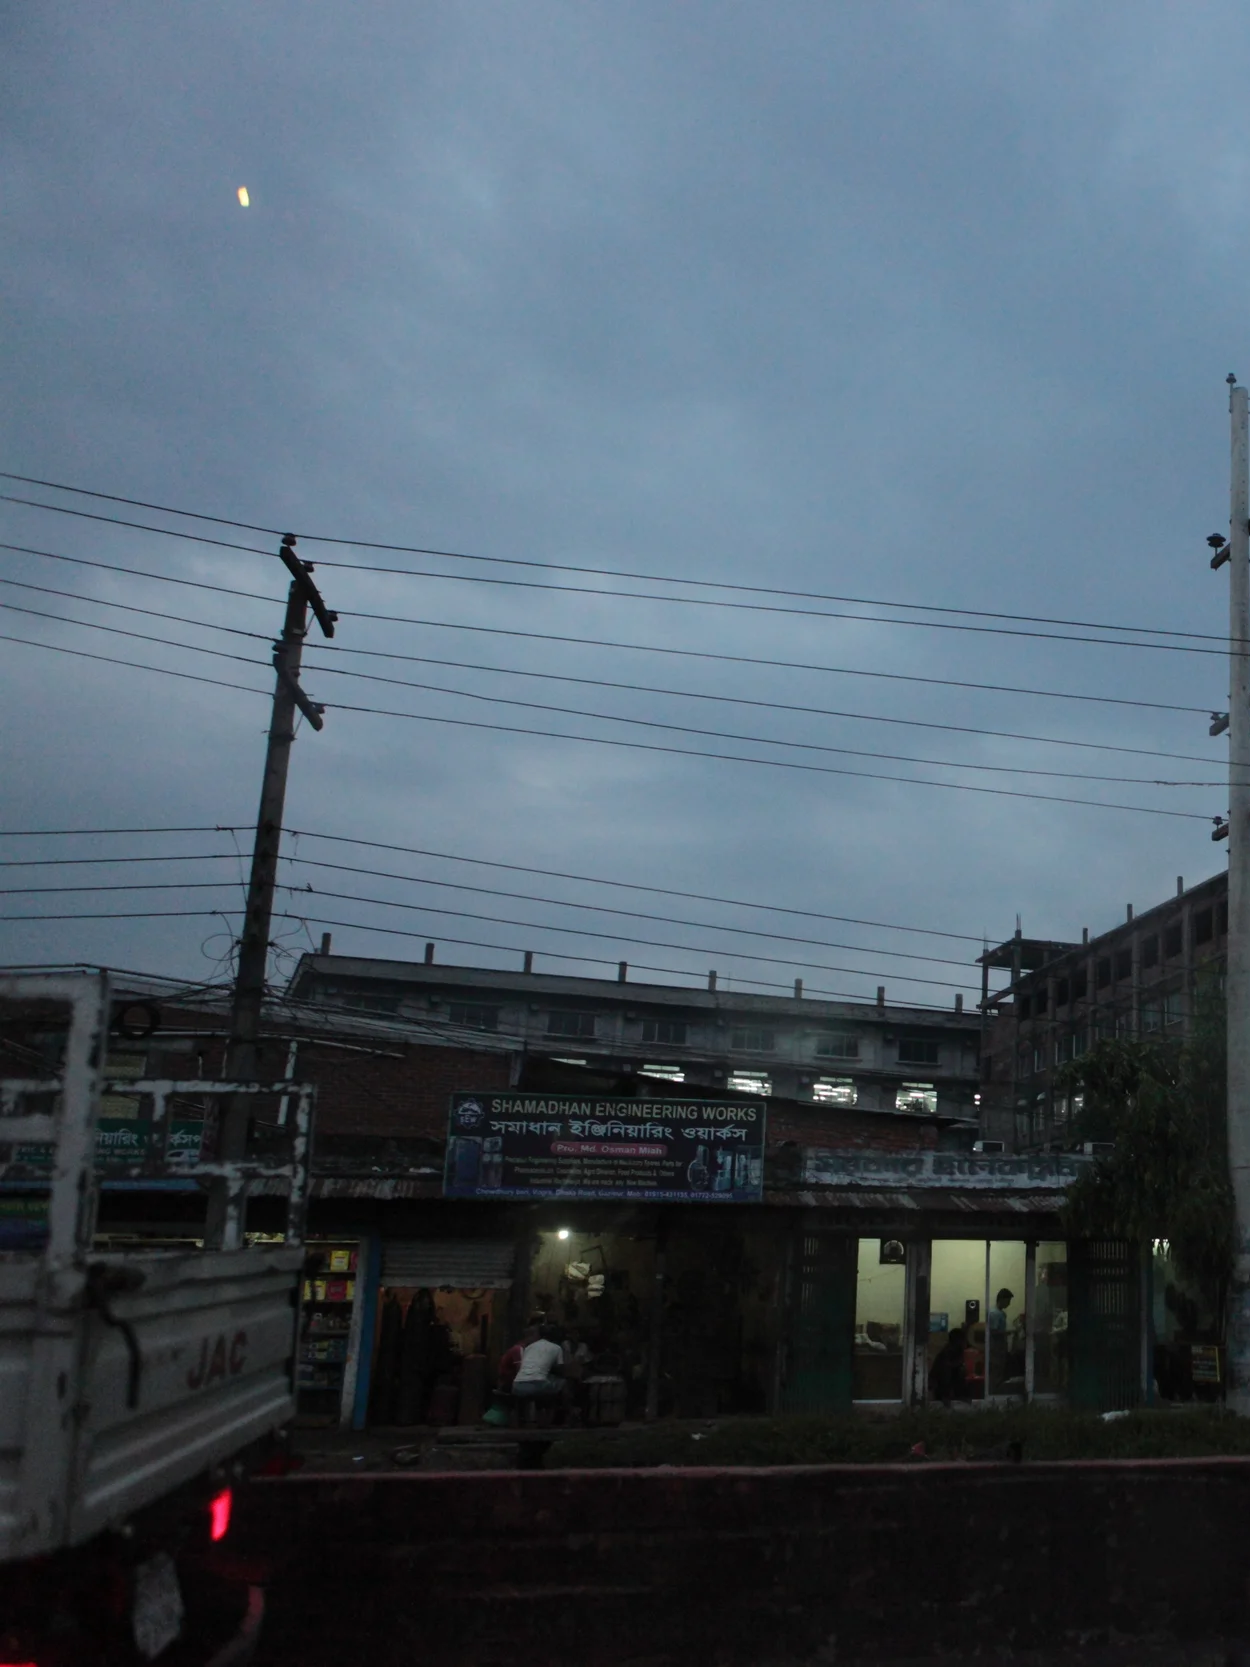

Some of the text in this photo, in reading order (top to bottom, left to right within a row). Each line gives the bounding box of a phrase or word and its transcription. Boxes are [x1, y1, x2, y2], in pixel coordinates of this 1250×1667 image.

[491, 1099, 757, 1121] SHAMADHAN ENGINEERING WORKS
[489, 1119, 748, 1142] সমাধান ইঞ্জিনিয়ারিং ওয়ার্কস
[601, 1145, 636, 1154] Osman
[187, 1331, 248, 1389] JAC
